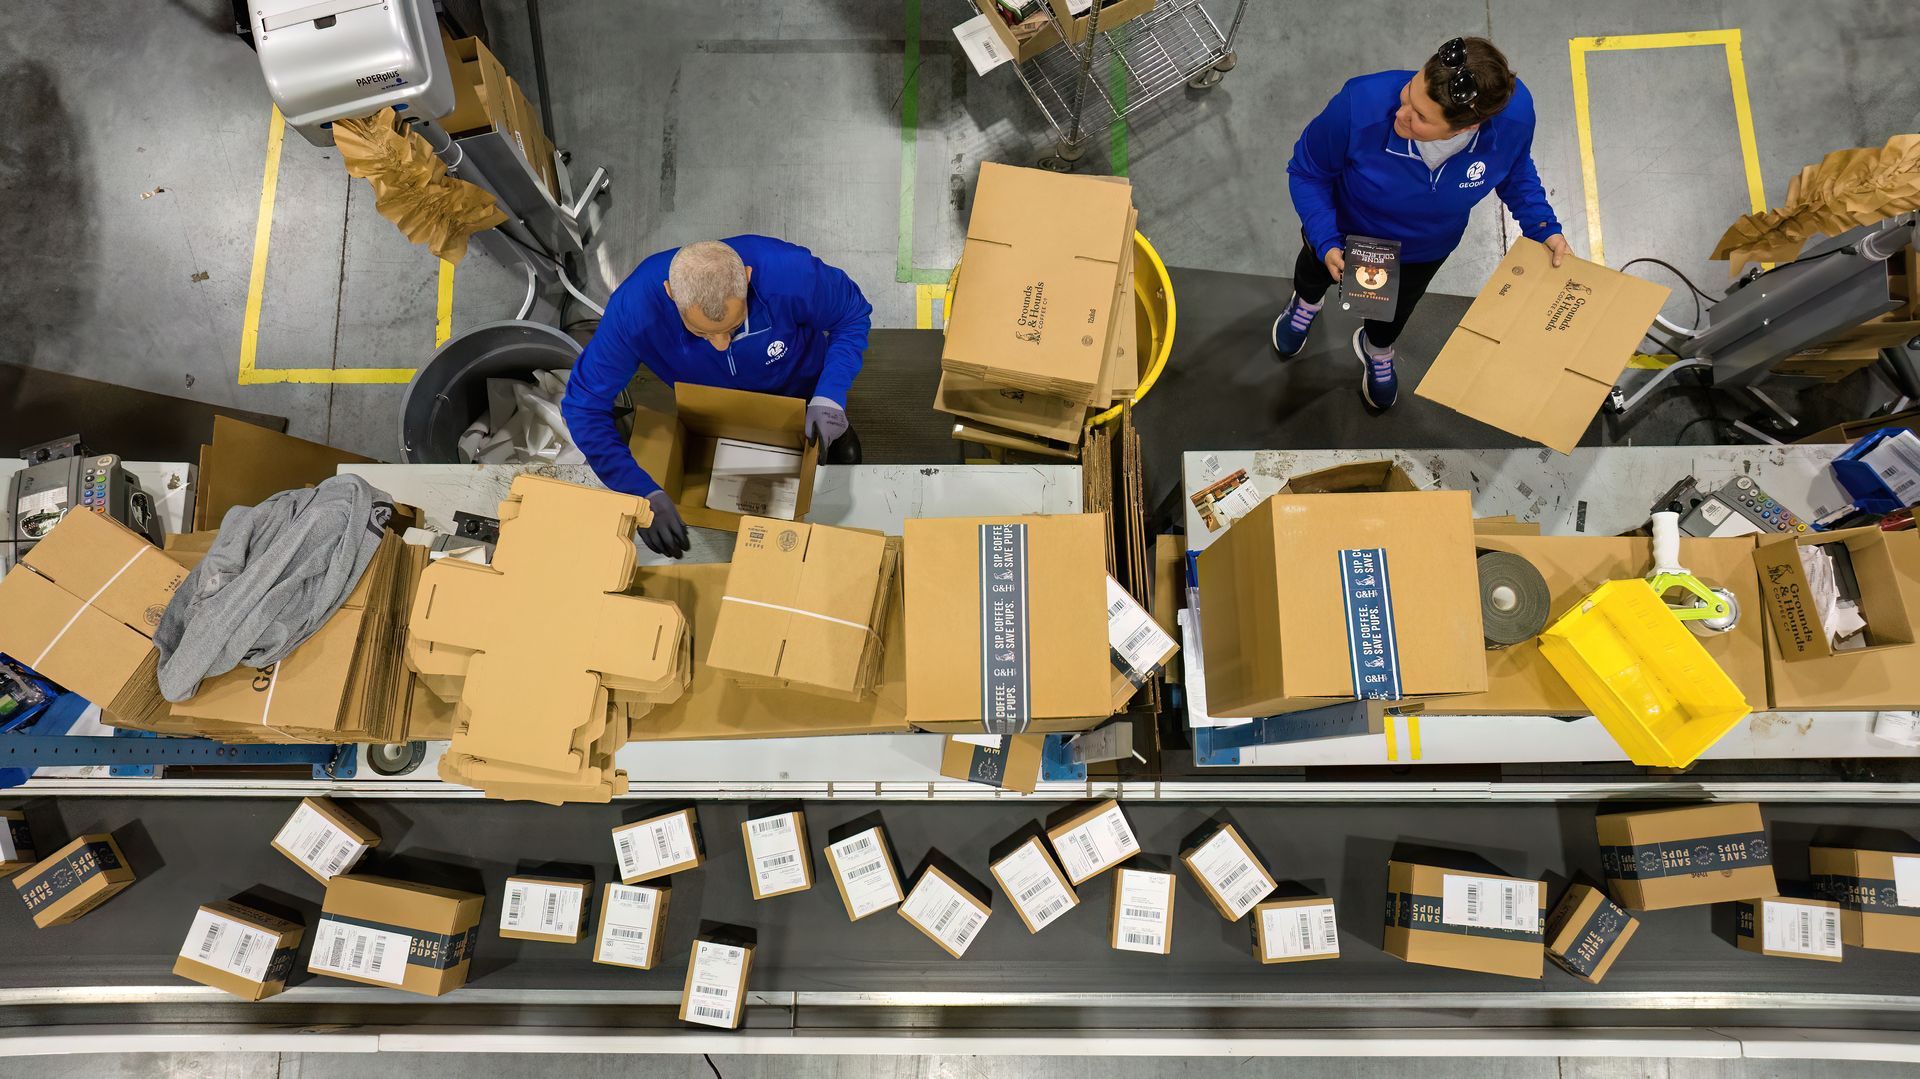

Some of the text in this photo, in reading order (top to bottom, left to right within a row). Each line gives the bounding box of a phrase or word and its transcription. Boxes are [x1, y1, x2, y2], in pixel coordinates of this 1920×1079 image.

[1017, 285, 1033, 326] Grounds
[1027, 281, 1045, 328] & Hounds
[1544, 293, 1576, 332] & Hounds
[1558, 297, 1586, 332] Grounds
[993, 553, 1003, 568] SIP
[1004, 547, 1014, 568] SAVE
[1353, 560, 1364, 574] SIP
[1362, 552, 1374, 573] SAVE
[992, 584, 1012, 593] G&H
[1355, 590, 1375, 599] G&H
[1780, 586, 1805, 652] & Hounds
[1790, 583, 1813, 642] Grounds
[994, 598, 1004, 649] SIP COFFEE.
[1005, 600, 1015, 649] SAVE PUPS.
[1359, 604, 1373, 656] SIP COFFEE.
[1369, 606, 1384, 655] SAVE PUPS.
[993, 668, 1014, 677] G&H
[1365, 674, 1385, 683] G&H
[995, 682, 1006, 718] COFFEE.
[1006, 685, 1016, 711] PUPS.
[1662, 848, 1690, 860] PUPS
[1717, 842, 1745, 853] PUPS
[1719, 851, 1747, 862] SAVE
[1664, 858, 1691, 869] SAVE
[22, 880, 50, 903] PUPS
[26, 888, 54, 910] SAVE
[1850, 895, 1877, 905] SAVE
[1412, 903, 1441, 914] PUPS
[1412, 912, 1440, 924] SAVE
[409, 946, 438, 959] PUPS
[411, 937, 439, 950] SAVE
[1577, 930, 1598, 956] SAVE
[1583, 936, 1604, 961] PUPS
